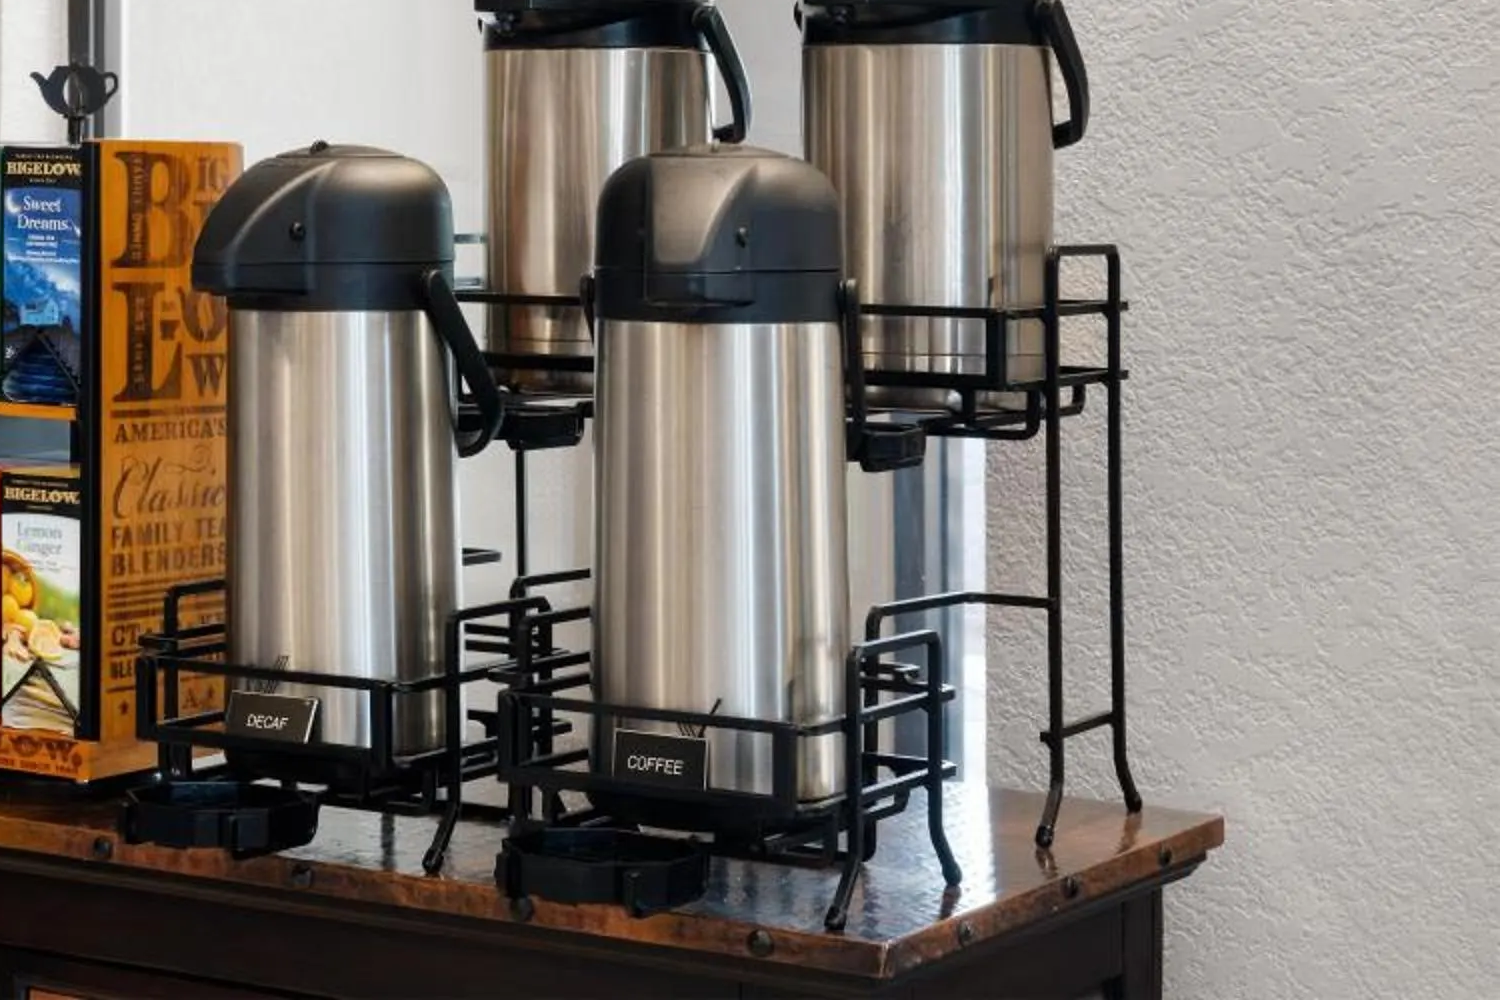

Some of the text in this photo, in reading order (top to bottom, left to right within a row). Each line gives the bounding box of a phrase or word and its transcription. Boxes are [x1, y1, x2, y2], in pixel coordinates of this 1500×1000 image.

[6, 161, 82, 176] BIGELOW
[22, 195, 63, 213] Sweet
[3, 486, 81, 505] BIGELOW
[111, 522, 185, 549] FAMILY
[111, 543, 226, 577] BLENDERS
[246, 713, 289, 730] DECAF
[627, 755, 685, 775] COFFEE
